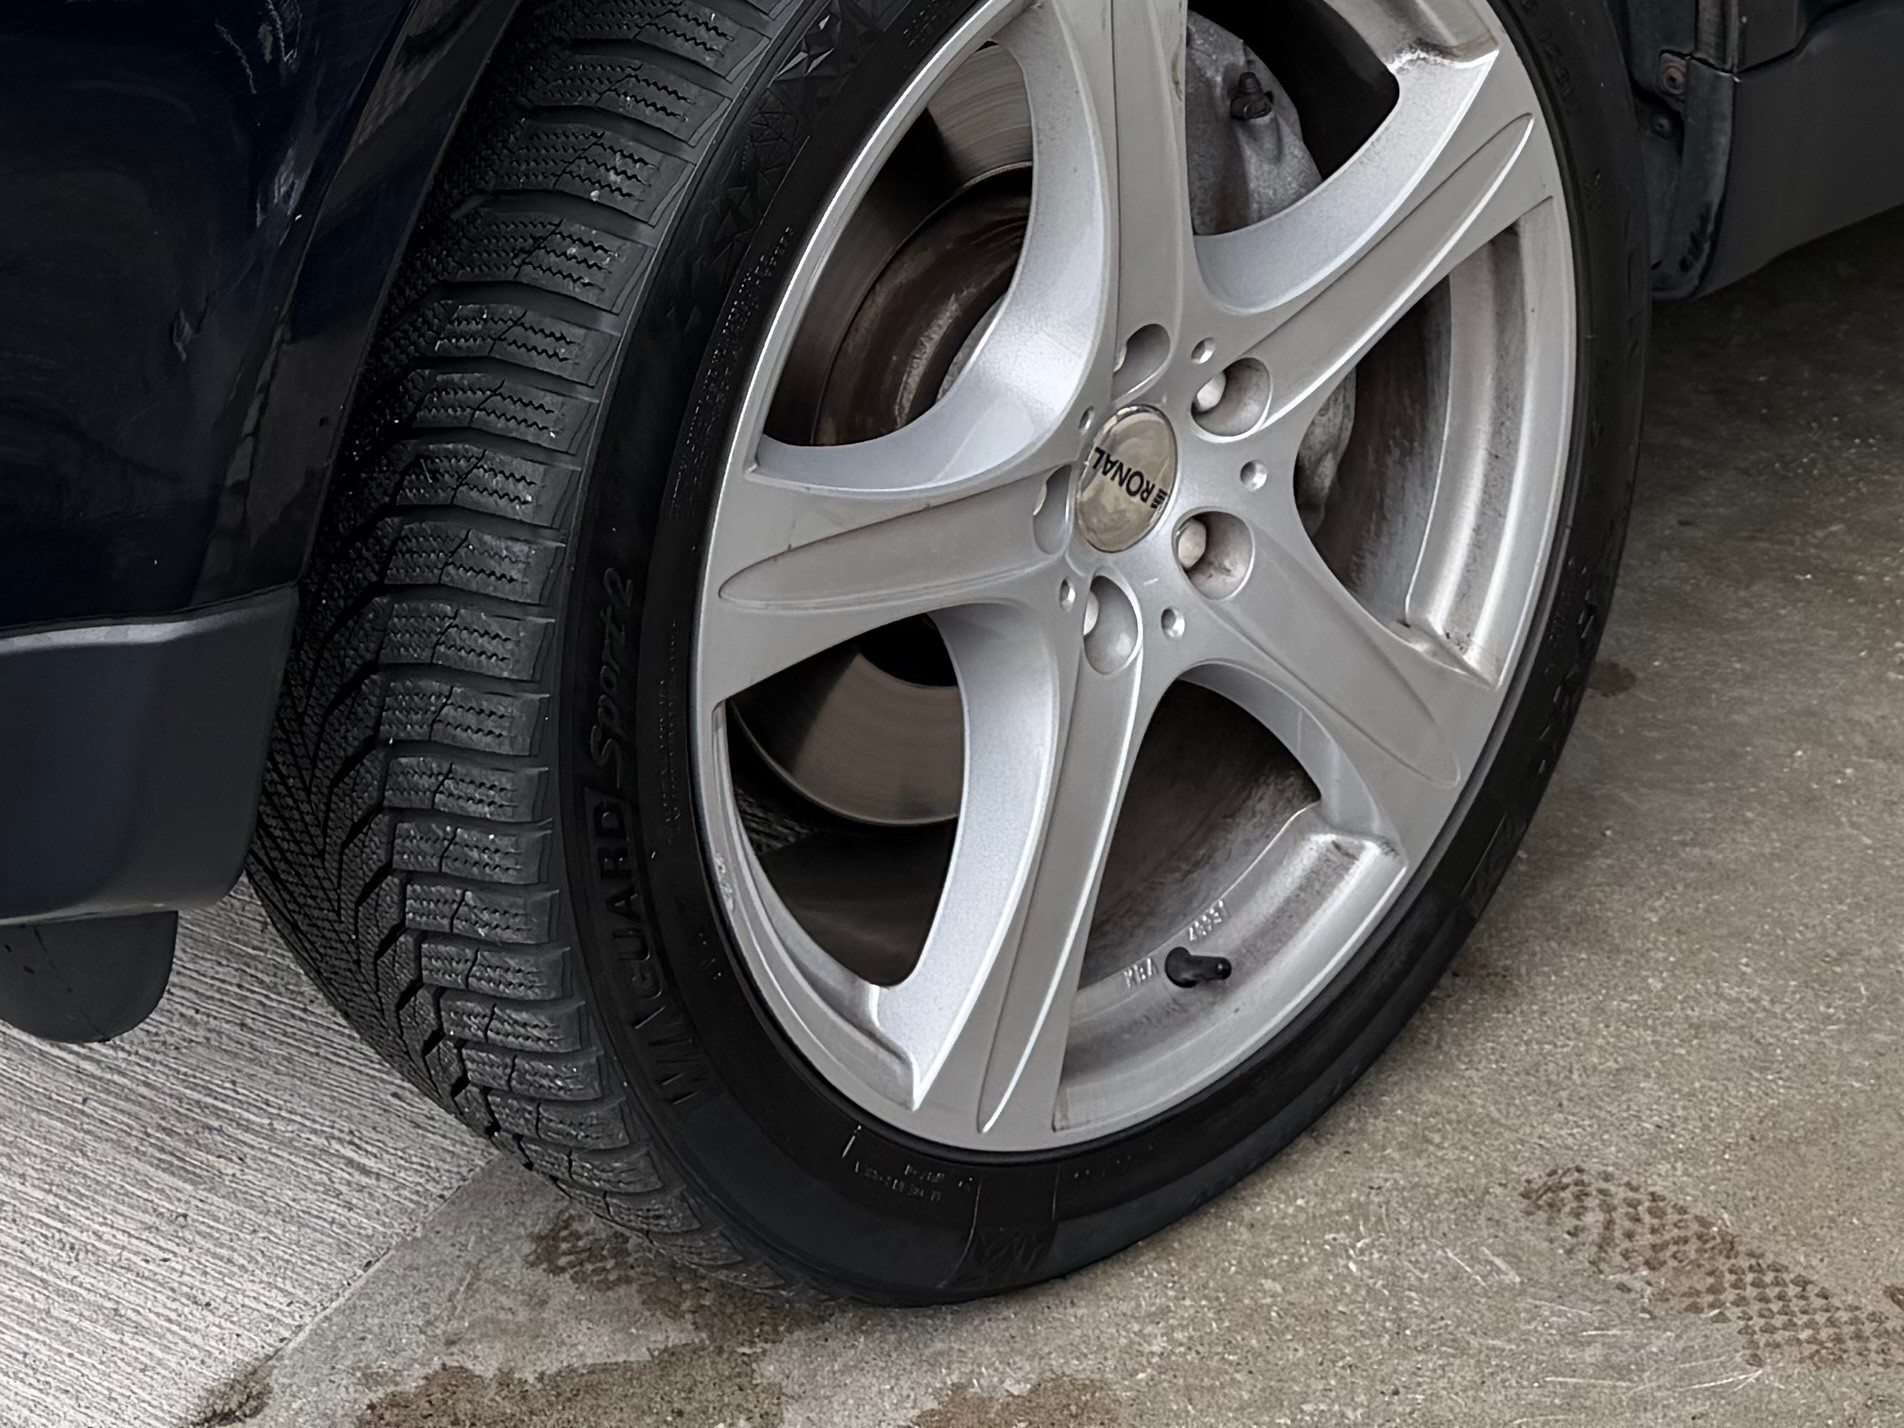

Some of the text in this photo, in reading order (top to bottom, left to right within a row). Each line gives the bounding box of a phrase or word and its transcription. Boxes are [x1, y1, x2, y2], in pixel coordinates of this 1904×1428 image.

[1092, 446, 1156, 504] RONAL
[602, 564, 634, 610] 2
[588, 603, 629, 789] Sport
